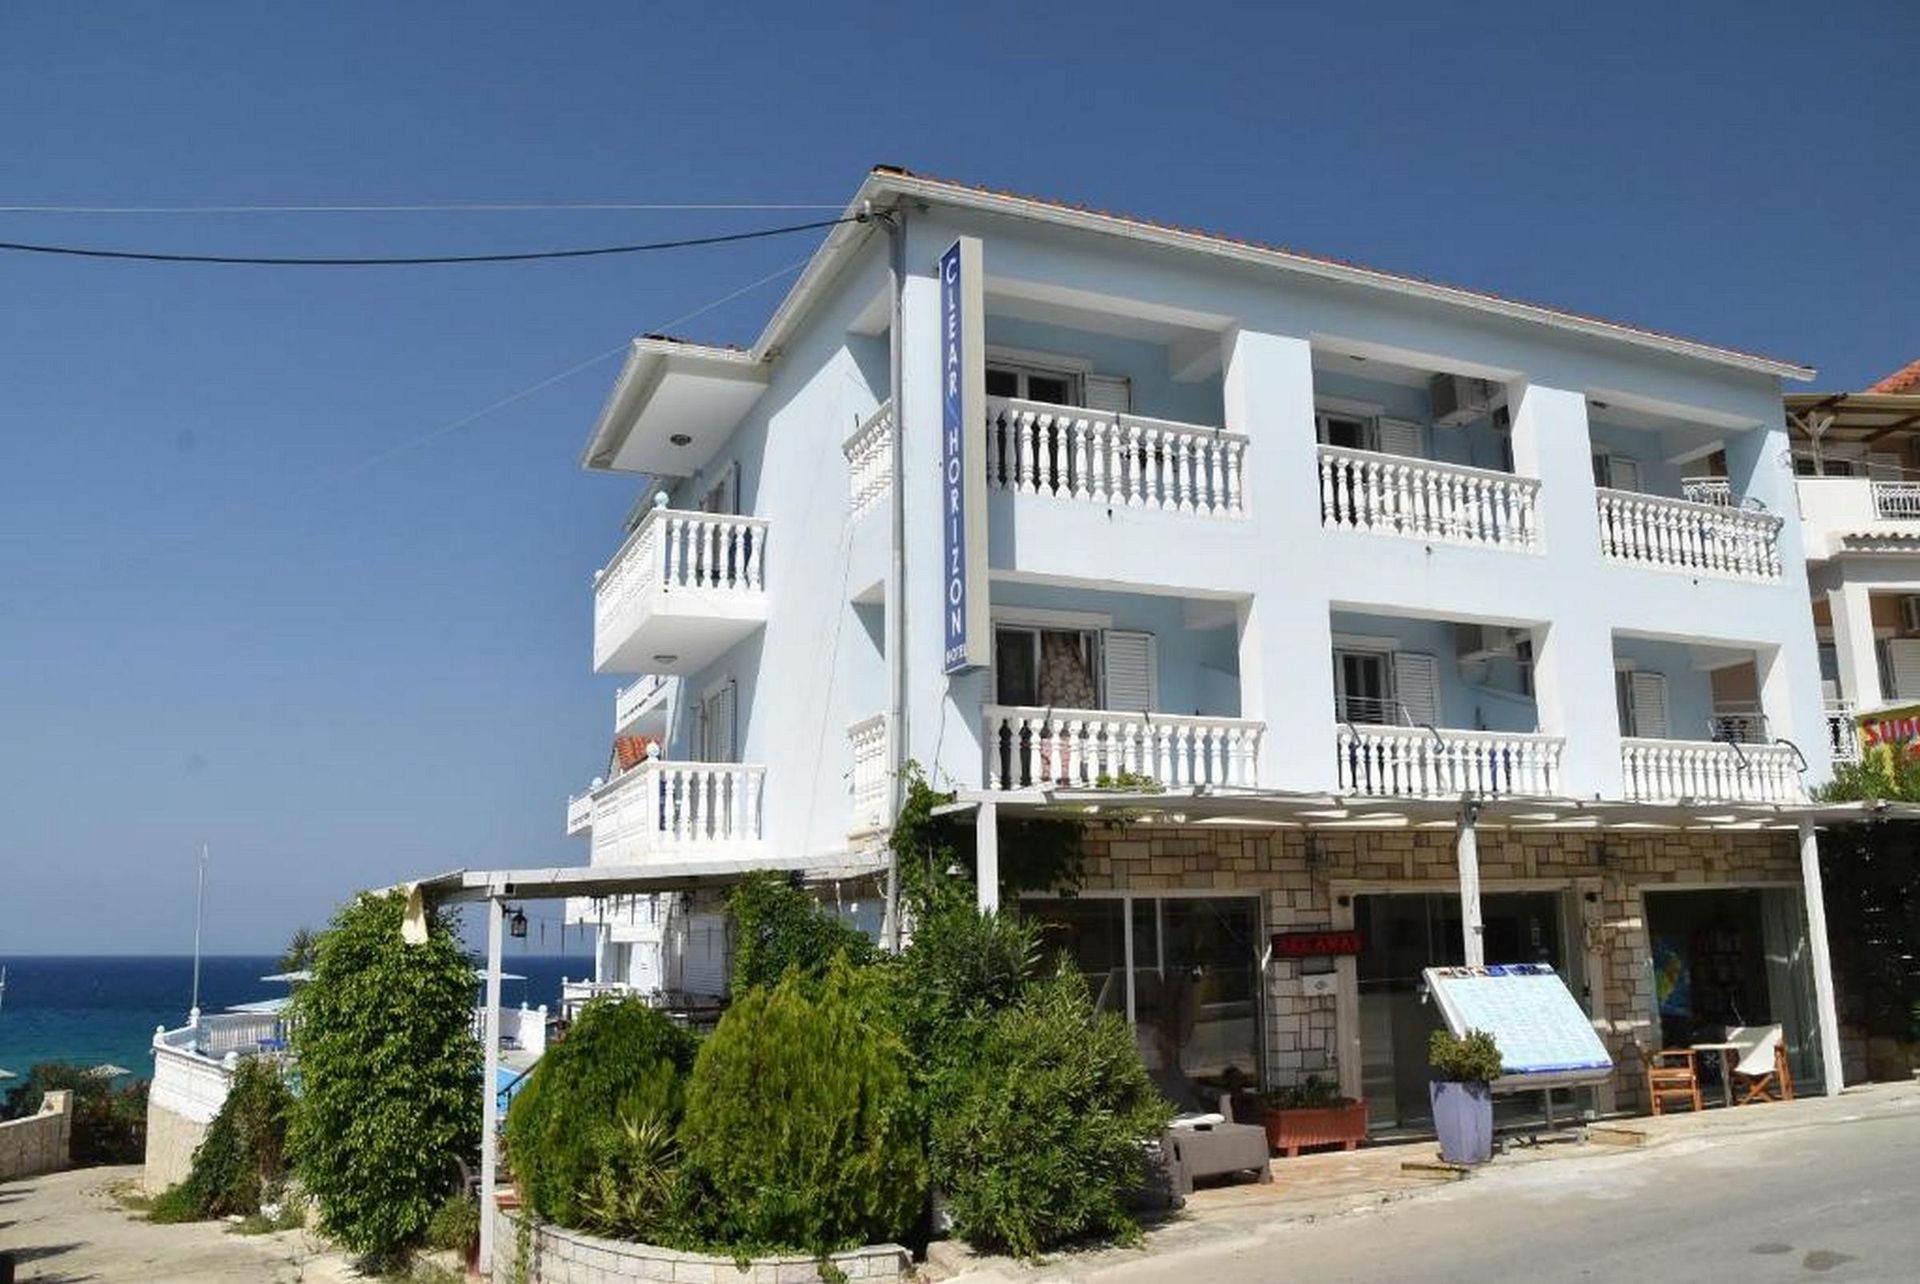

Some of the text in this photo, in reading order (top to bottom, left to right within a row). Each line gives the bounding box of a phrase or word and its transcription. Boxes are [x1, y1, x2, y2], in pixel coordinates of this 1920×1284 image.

[945, 257, 962, 637] CLEAR HORIZON
[946, 644, 967, 664] HOTEL
